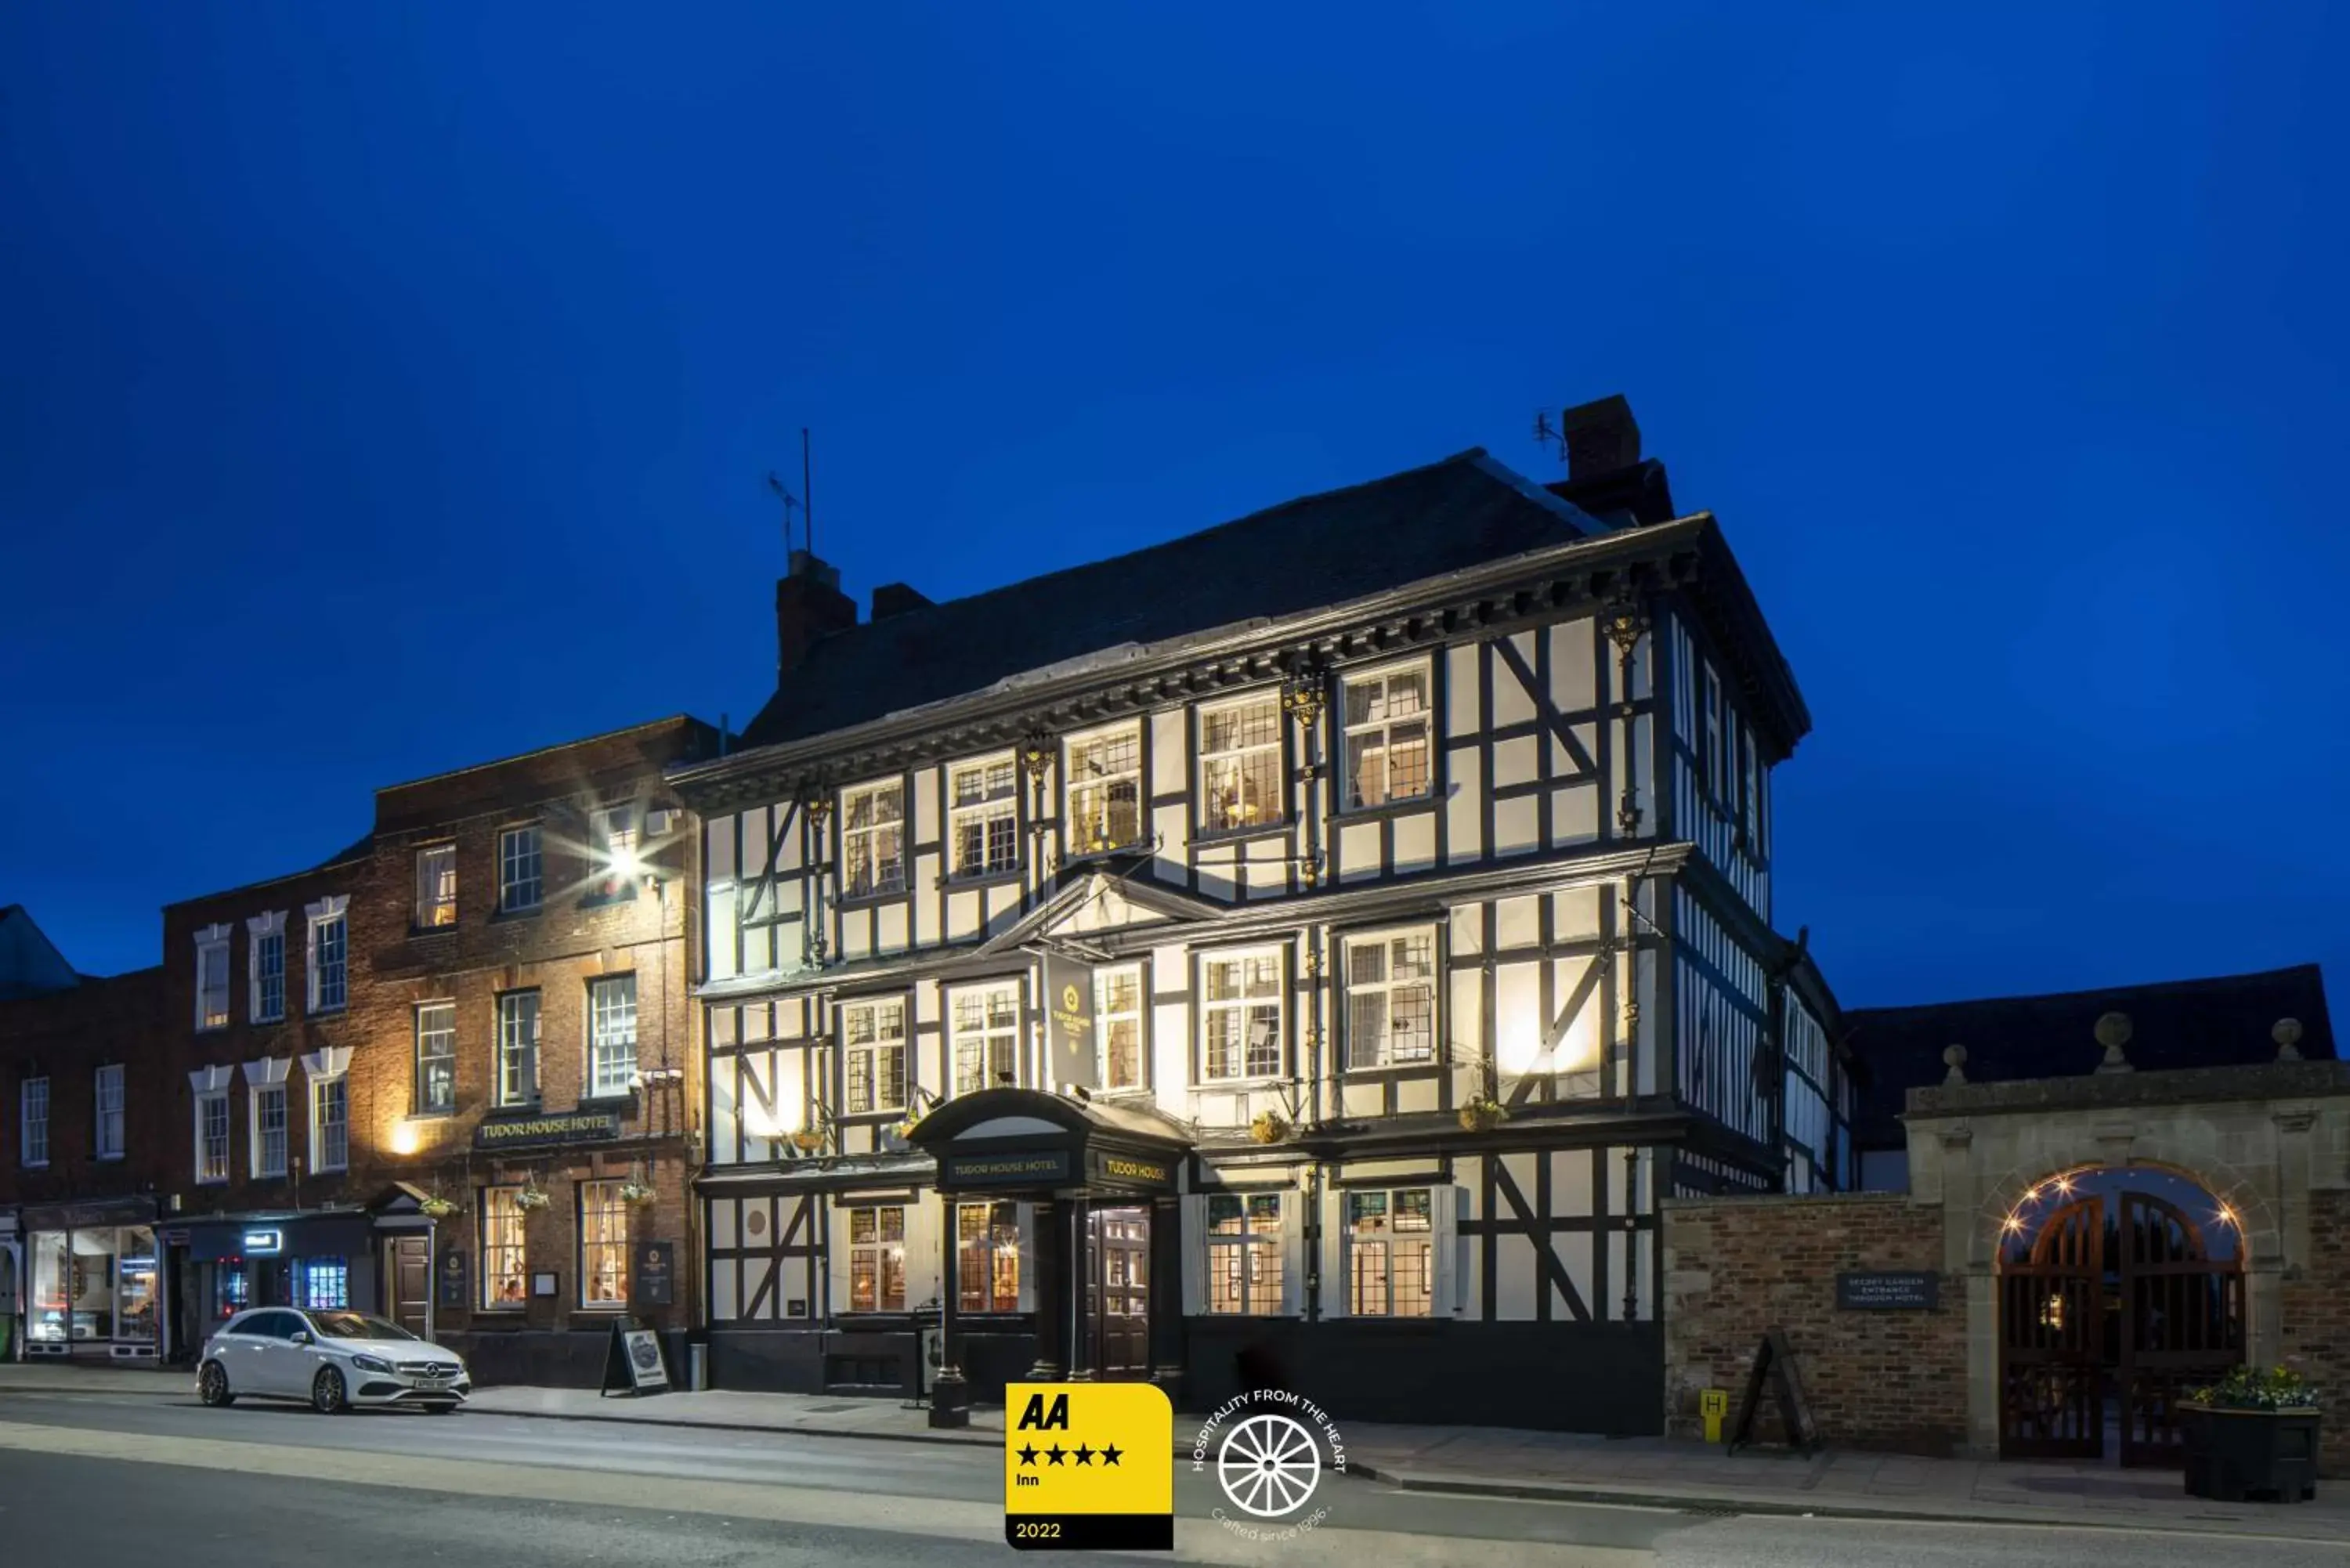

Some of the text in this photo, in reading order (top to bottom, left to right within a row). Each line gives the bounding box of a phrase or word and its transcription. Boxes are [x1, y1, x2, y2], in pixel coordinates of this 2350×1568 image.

[483, 1115, 613, 1140] TUDOR HOUSE HOTEL
[954, 1159, 1059, 1175] TUDOR HOUSE HOTEL
[1108, 1160, 1166, 1180] TUDOR HOUSE
[1706, 1396, 1720, 1411] H
